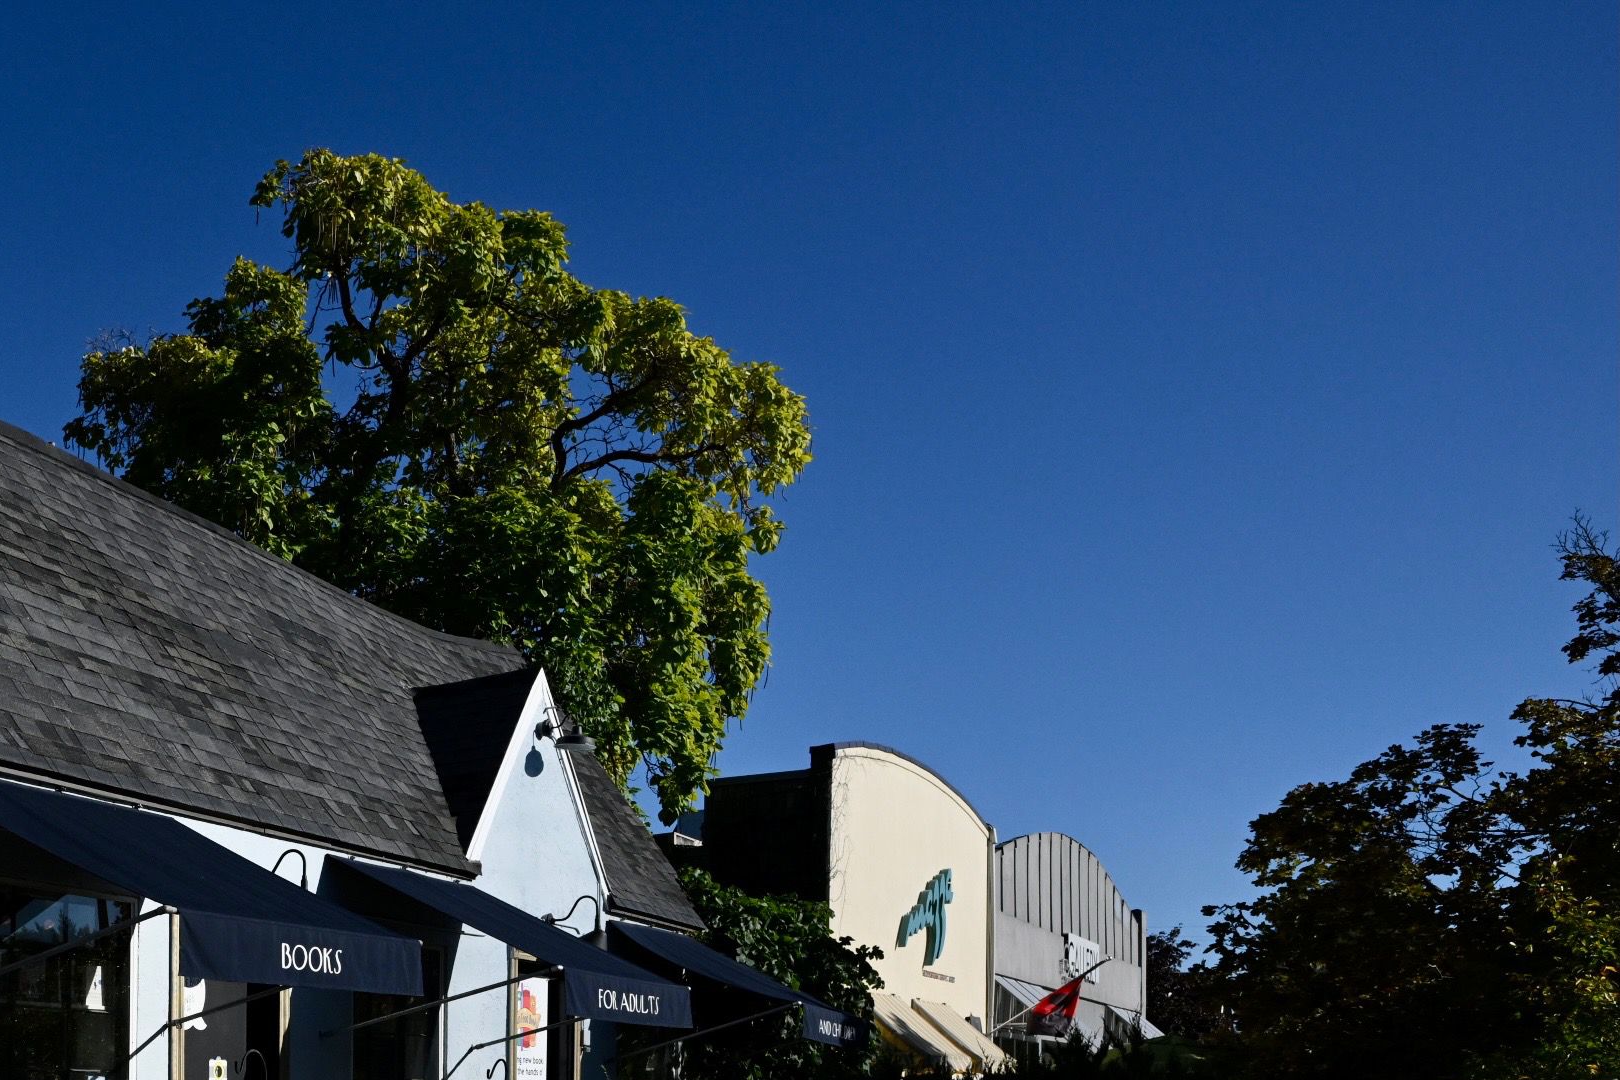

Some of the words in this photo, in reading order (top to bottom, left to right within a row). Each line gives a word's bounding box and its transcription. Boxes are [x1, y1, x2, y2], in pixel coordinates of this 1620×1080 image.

[281, 943, 342, 974] BOOKS
[598, 988, 619, 1011] FOR
[620, 992, 660, 1015] ADULTS
[818, 1018, 831, 1036] AND
